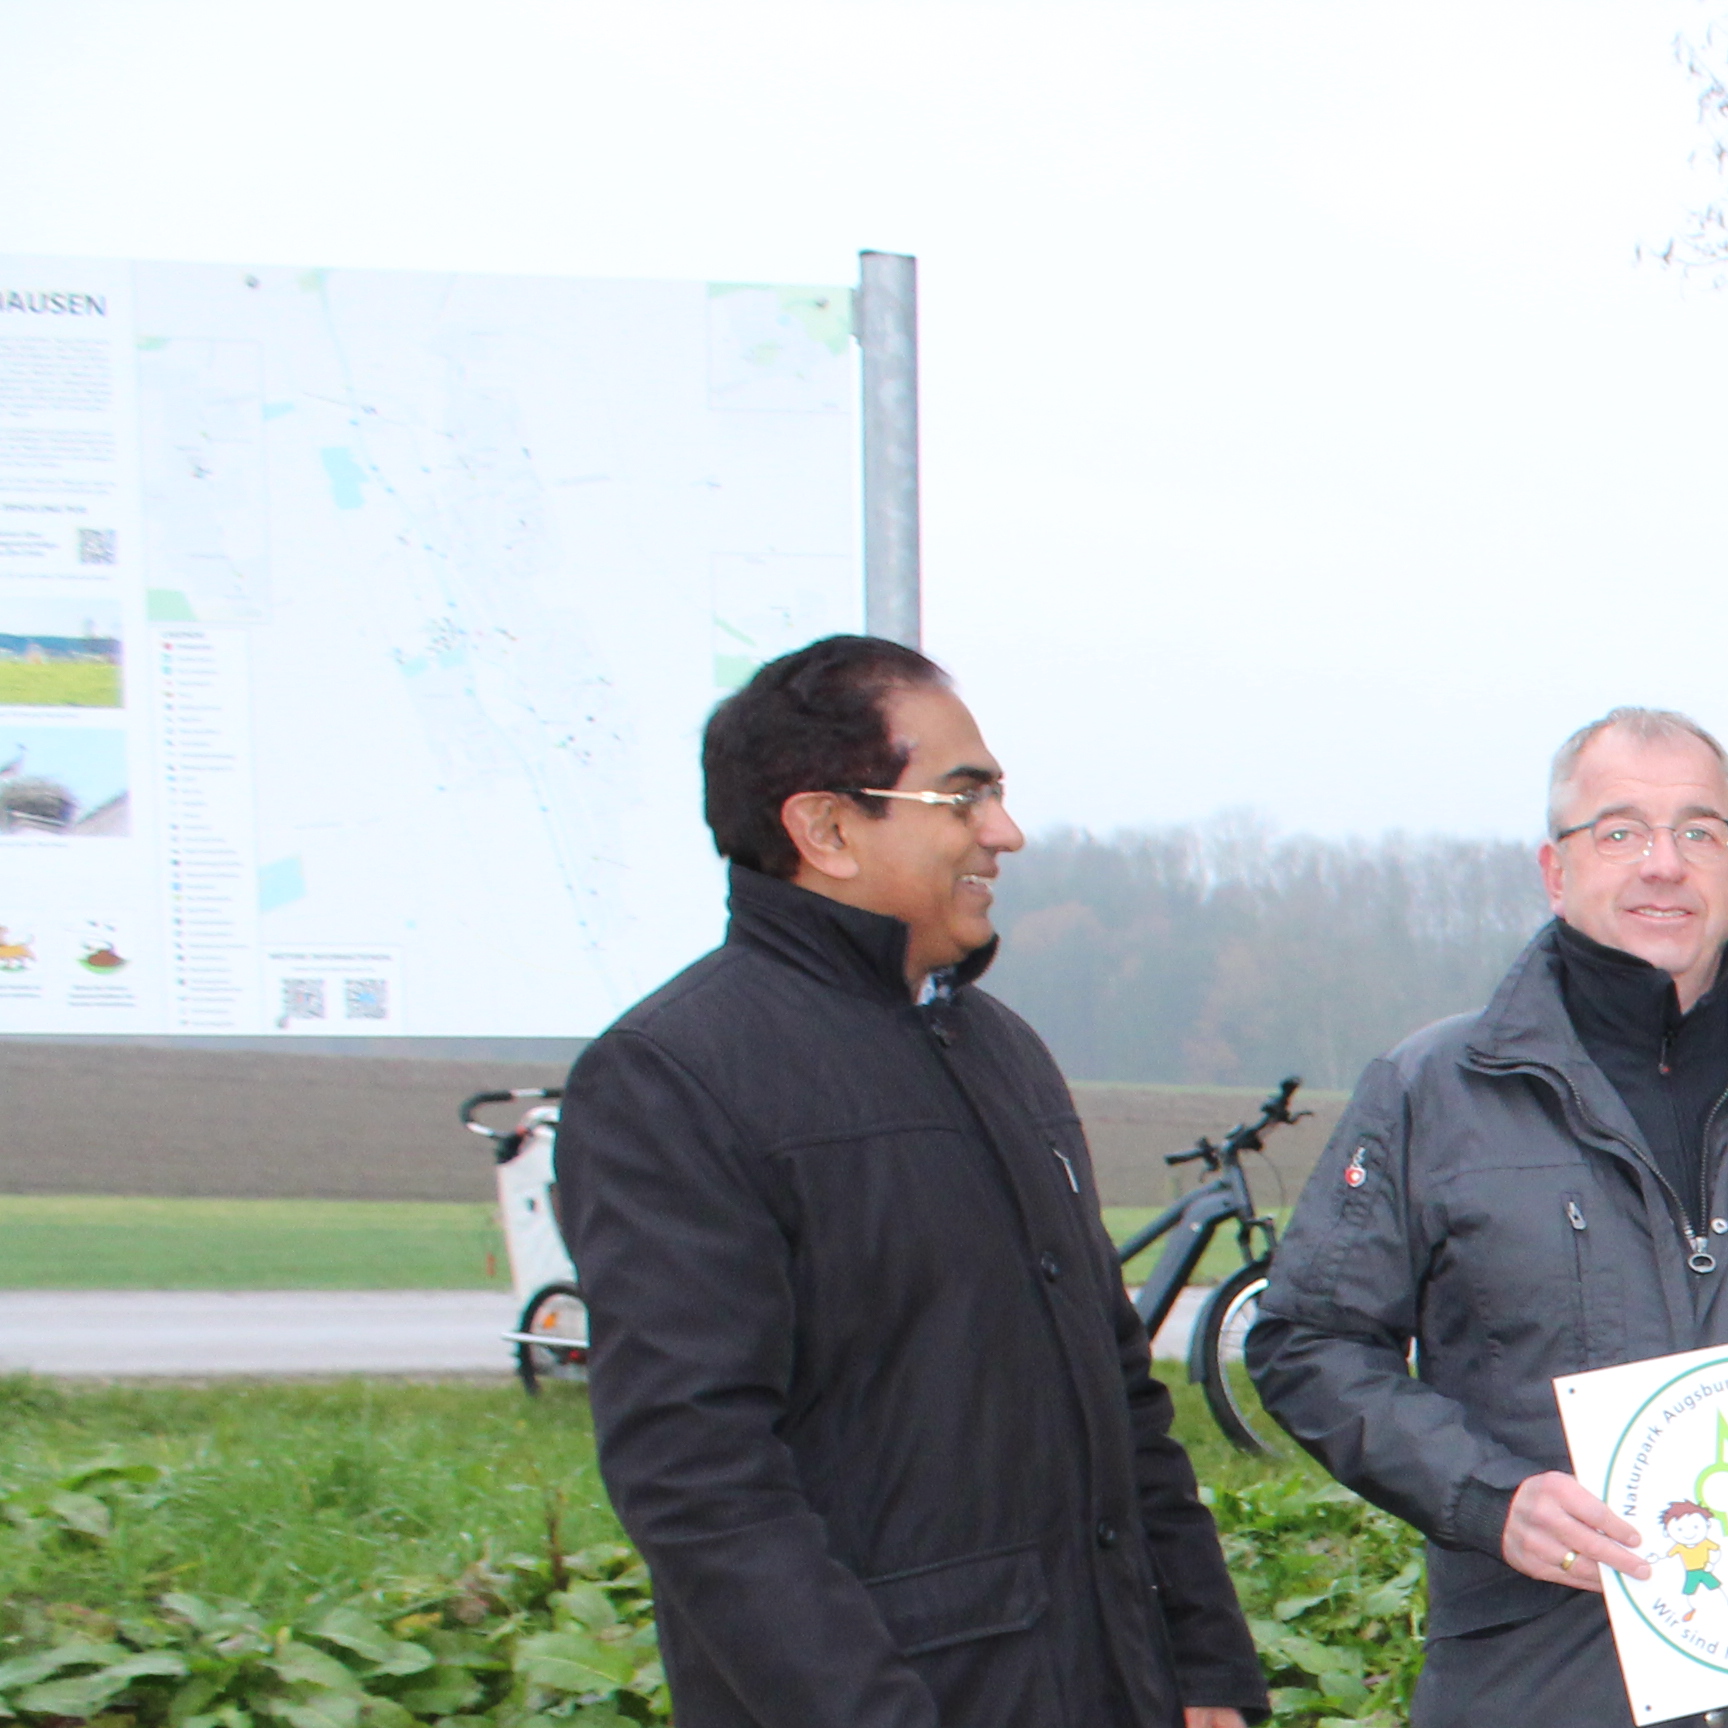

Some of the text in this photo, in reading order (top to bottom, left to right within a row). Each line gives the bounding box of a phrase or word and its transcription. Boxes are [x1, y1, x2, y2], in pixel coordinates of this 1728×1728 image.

[0, 290, 106, 317] AUSEN
[1624, 1426, 1662, 1516] Naturpark
[1653, 1598, 1678, 1627] Wir
[1682, 1628, 1719, 1654] sind
